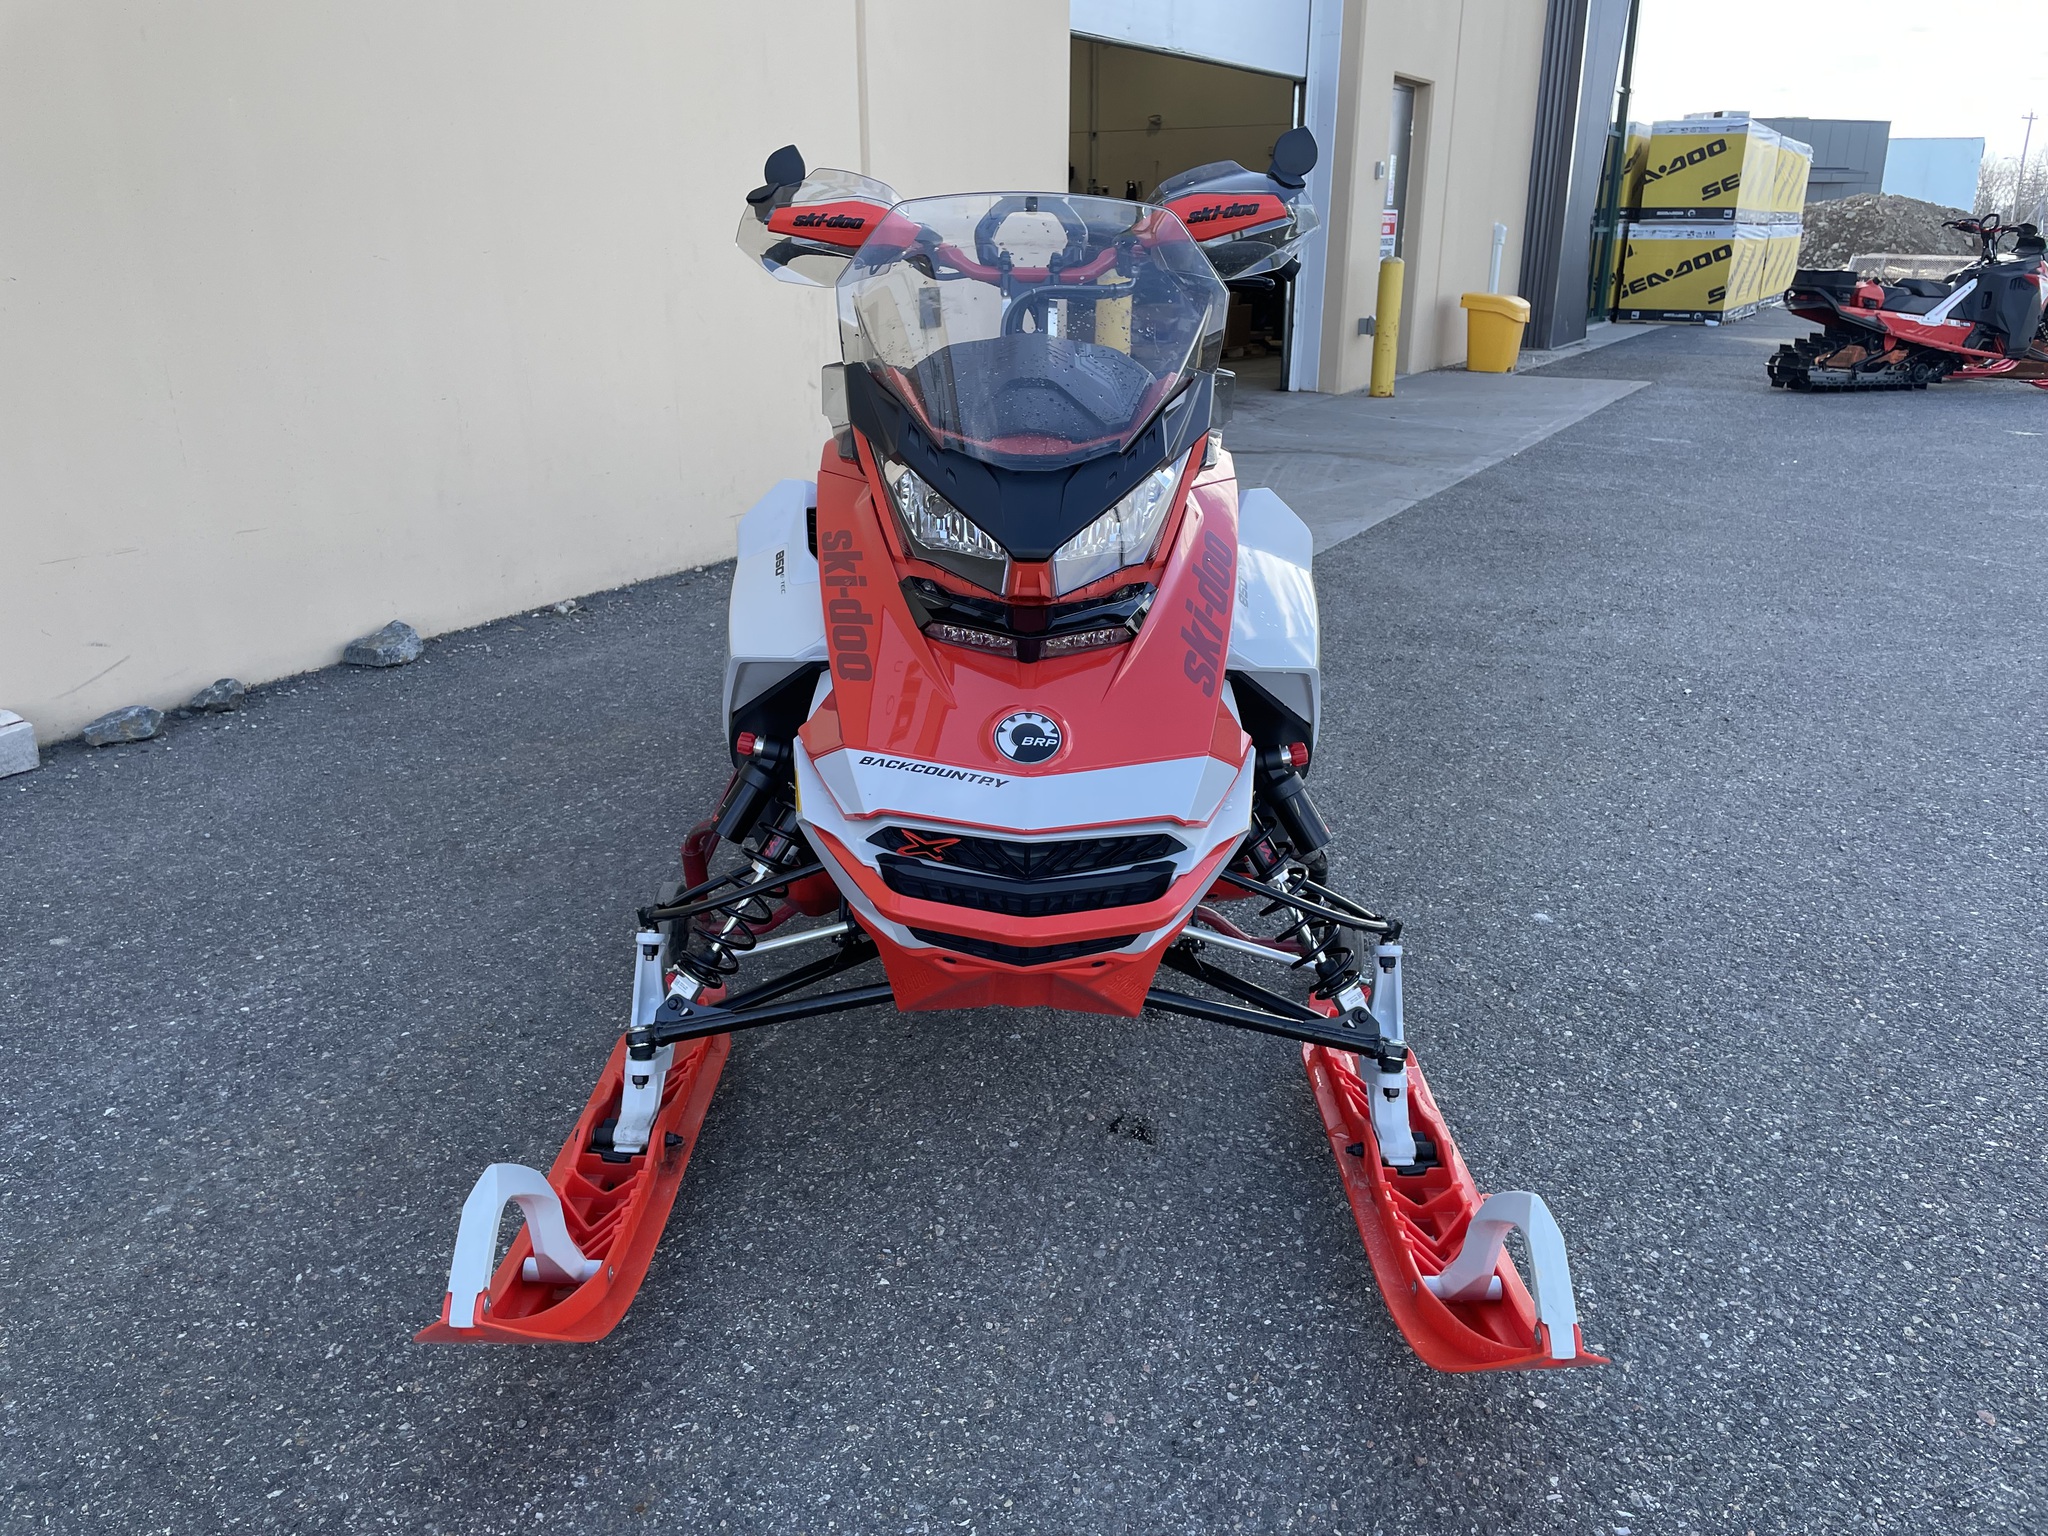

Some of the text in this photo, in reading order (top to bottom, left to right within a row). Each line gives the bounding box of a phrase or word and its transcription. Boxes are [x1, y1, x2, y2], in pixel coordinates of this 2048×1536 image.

[792, 212, 866, 230] ski-doo
[1187, 202, 1260, 224] ski-doo
[775, 549, 785, 577] 850
[821, 529, 874, 682] ski-doo
[1180, 529, 1233, 698] ski-doo
[1021, 736, 1058, 747] BRP
[858, 756, 1011, 788] BACKCOUNTRY
